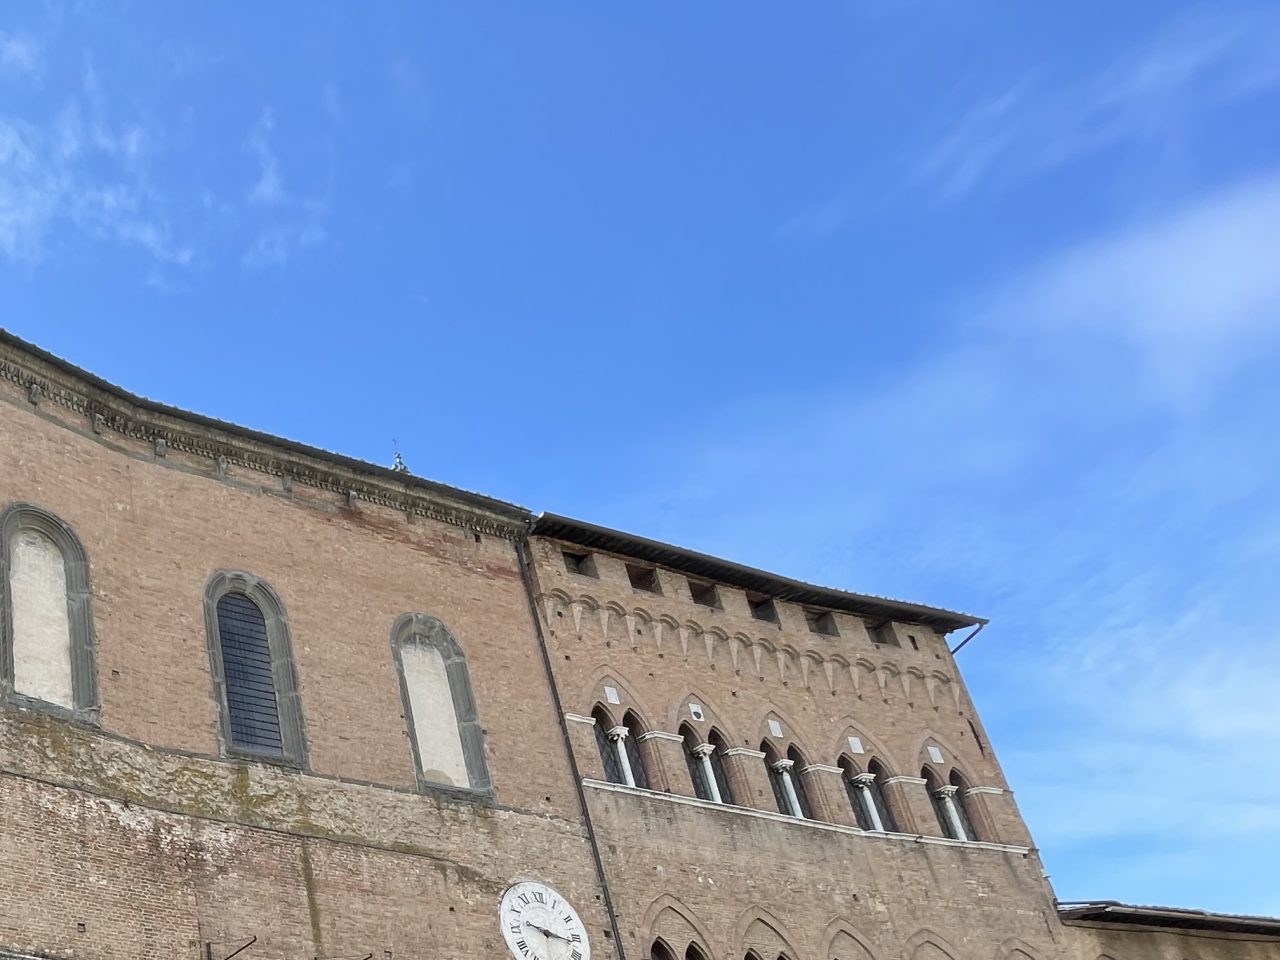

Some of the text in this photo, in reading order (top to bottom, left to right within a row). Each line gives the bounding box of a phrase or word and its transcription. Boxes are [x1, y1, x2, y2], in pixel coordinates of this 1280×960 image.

[532, 891, 547, 905] XII
[563, 915, 573, 924] II
[570, 933, 582, 943] III
[516, 939, 530, 957] VIII
